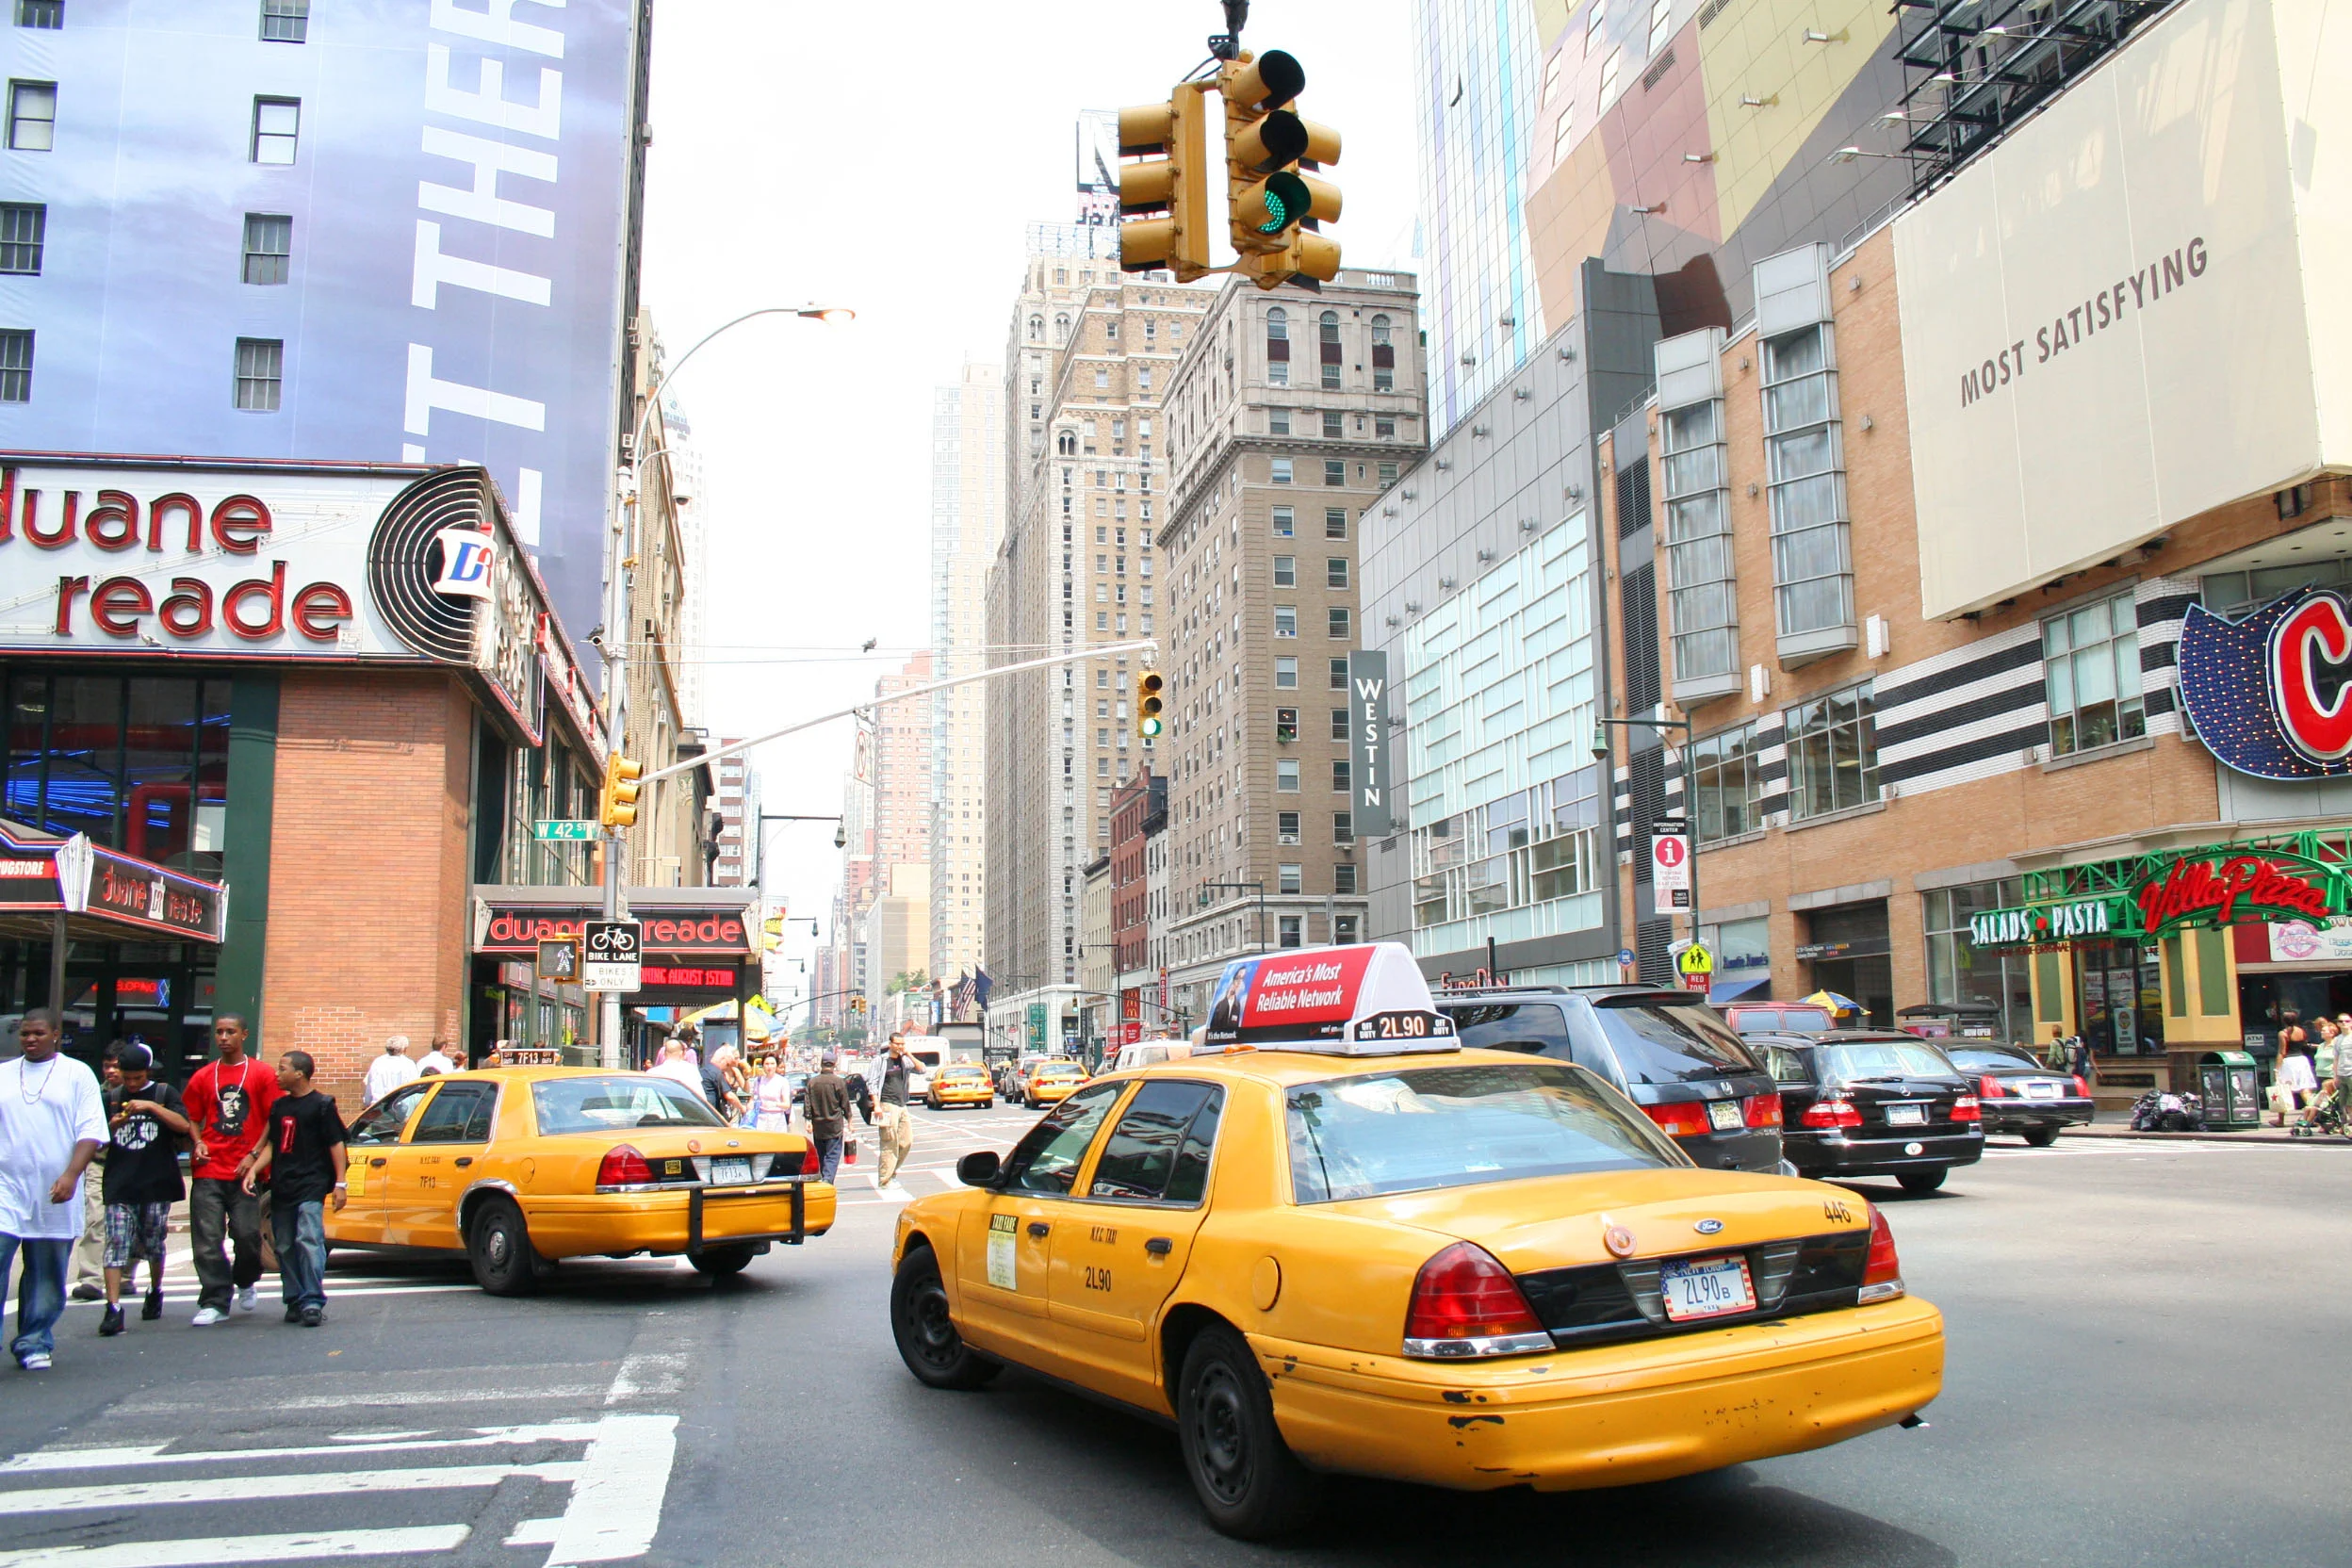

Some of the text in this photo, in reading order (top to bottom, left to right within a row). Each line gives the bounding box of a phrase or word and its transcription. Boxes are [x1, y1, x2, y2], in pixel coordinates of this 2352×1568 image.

[1961, 237, 2207, 408] MOST SATISFYING
[0, 467, 272, 554] uane
[56, 560, 353, 641] reade
[1355, 678, 1382, 807] WESTIN
[538, 823, 549, 838] W
[554, 823, 574, 838] 42
[0, 860, 44, 875] UGSTORE
[102, 864, 147, 910] duane
[2137, 856, 2329, 934] Villa Pizza
[643, 914, 742, 942] reade
[1970, 901, 2109, 945] SALADS PASTA
[588, 953, 637, 961] BIKE LANE
[668, 969, 703, 986] AUGUST
[1263, 962, 1342, 988] America's Most
[1255, 986, 1343, 1012] Reliable Network
[1380, 1016, 1425, 1037] 2L90
[518, 1052, 538, 1064] 7F13
[419, 1175, 436, 1188] 7F13
[1700, 1219, 1719, 1231] Ford
[1822, 1200, 1852, 1224] 446
[1086, 1266, 1111, 1292] 2L90
